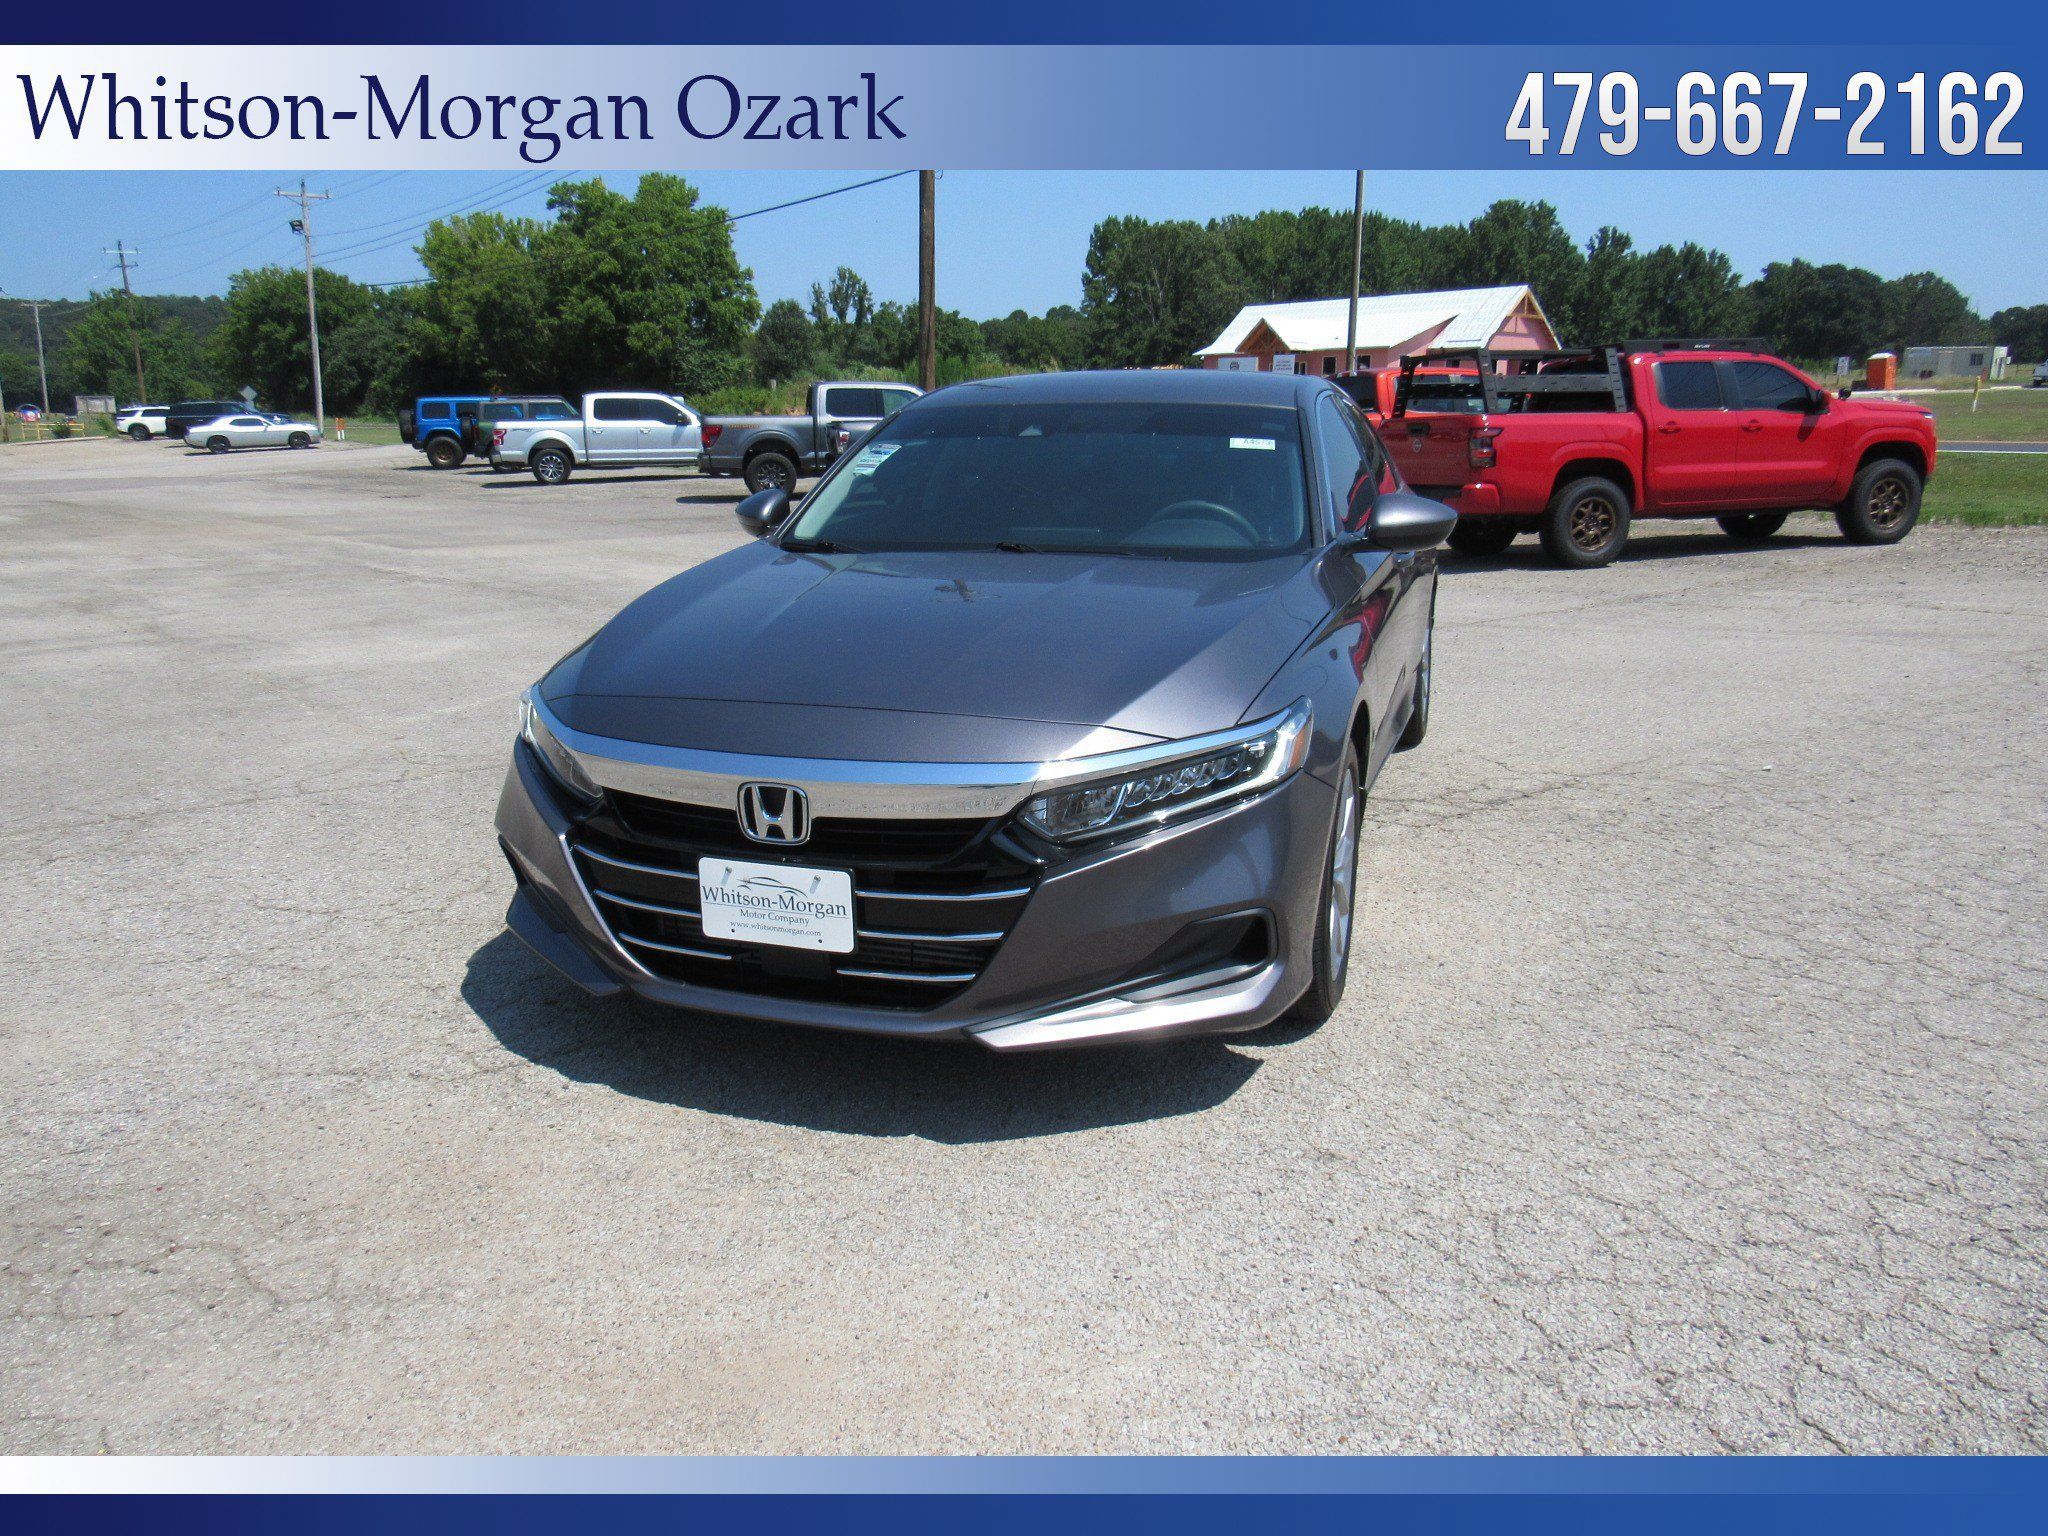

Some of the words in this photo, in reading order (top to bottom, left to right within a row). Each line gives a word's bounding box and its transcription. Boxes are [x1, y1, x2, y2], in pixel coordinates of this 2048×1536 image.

[702, 885, 847, 919] Whitson-Morgan
[740, 909, 766, 920] Motor
[768, 912, 810, 927] Company
[729, 921, 822, 937] www.whitsonmorgan.com
